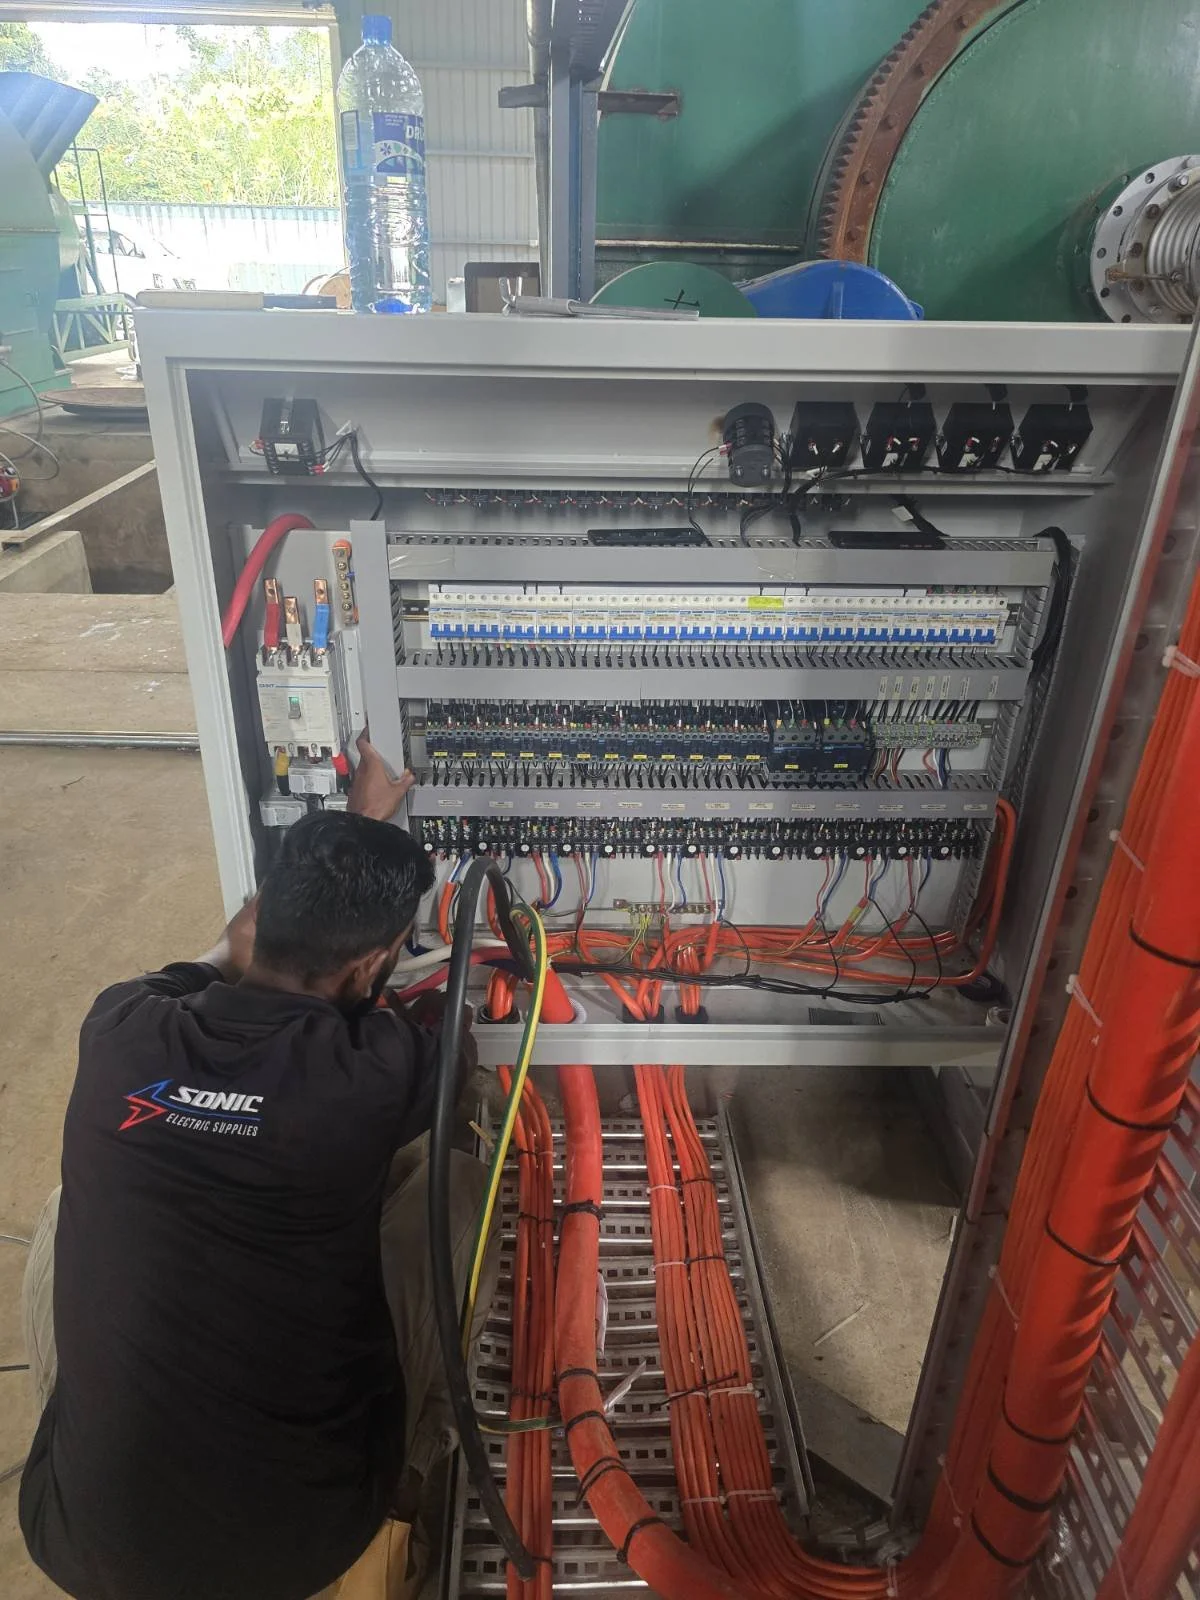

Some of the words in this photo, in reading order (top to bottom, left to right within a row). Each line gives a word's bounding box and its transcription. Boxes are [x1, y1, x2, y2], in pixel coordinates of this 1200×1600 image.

[169, 1086, 264, 1112] SONIC
[166, 1113, 210, 1131] ELECTRIC
[212, 1121, 258, 1136] SUPPLIES
